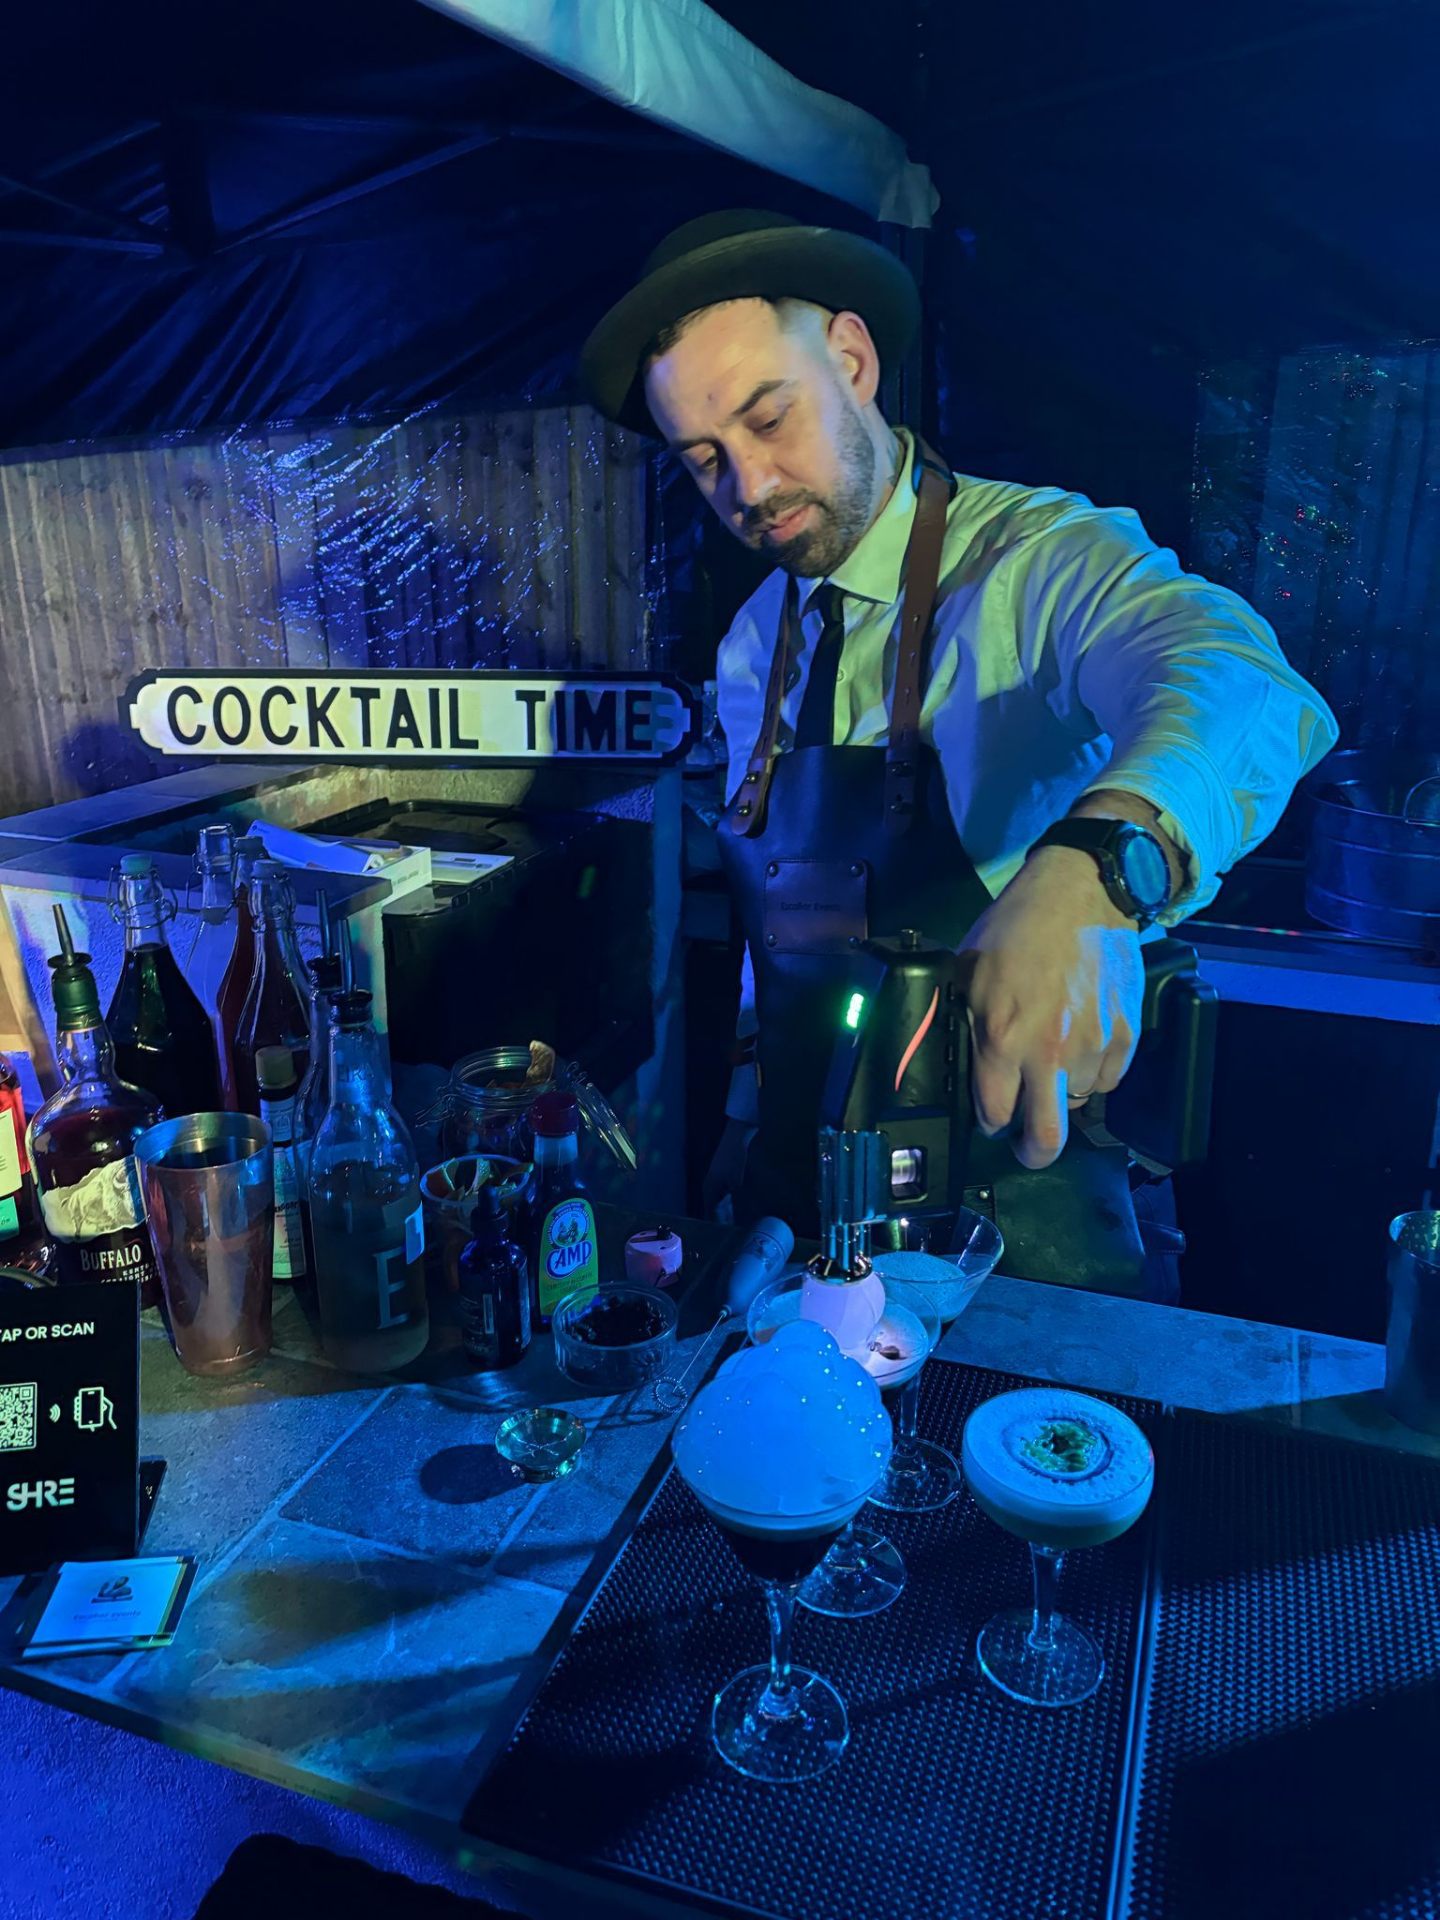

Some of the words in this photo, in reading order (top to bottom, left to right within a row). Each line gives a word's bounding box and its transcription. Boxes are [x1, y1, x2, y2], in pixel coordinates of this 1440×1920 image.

[166, 685, 479, 750] COCKTAIL
[515, 689, 653, 752] TIME
[80, 1244, 142, 1271] BUFFALO
[546, 1240, 592, 1279] CAMP
[372, 1246, 409, 1330] E
[0, 1328, 22, 1342] AP
[25, 1326, 48, 1340] OR
[51, 1321, 95, 1338] SCAN
[6, 1477, 75, 1511] SHRE
